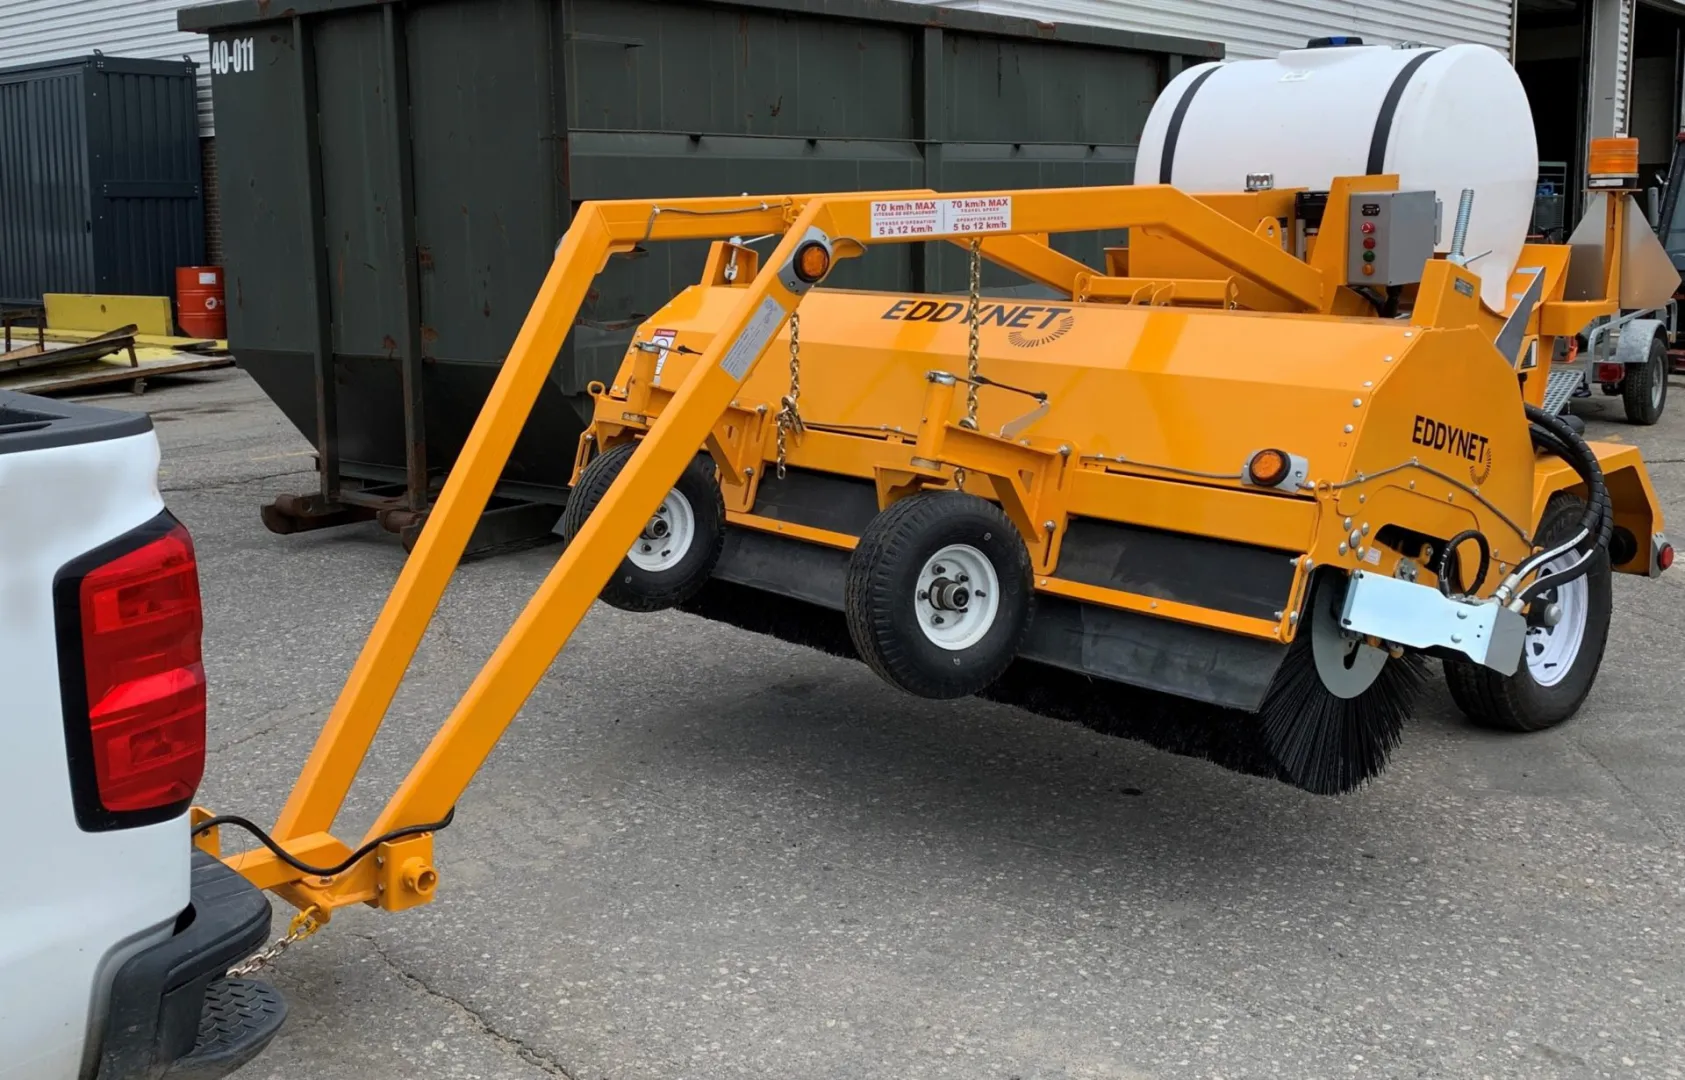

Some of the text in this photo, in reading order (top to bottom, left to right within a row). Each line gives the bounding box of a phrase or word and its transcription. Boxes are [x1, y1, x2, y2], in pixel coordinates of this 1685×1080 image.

[212, 37, 254, 75] 40-011
[875, 201, 936, 211] 70 km/h MAX
[951, 198, 1008, 208] 70 km/h MAX
[879, 226, 885, 235] 5
[897, 225, 908, 234] 12
[911, 225, 933, 233] km/h
[953, 220, 1007, 231] 5 to 12 km/h
[881, 300, 1072, 329] EDDYNET
[1412, 414, 1489, 463] EDDYNET
